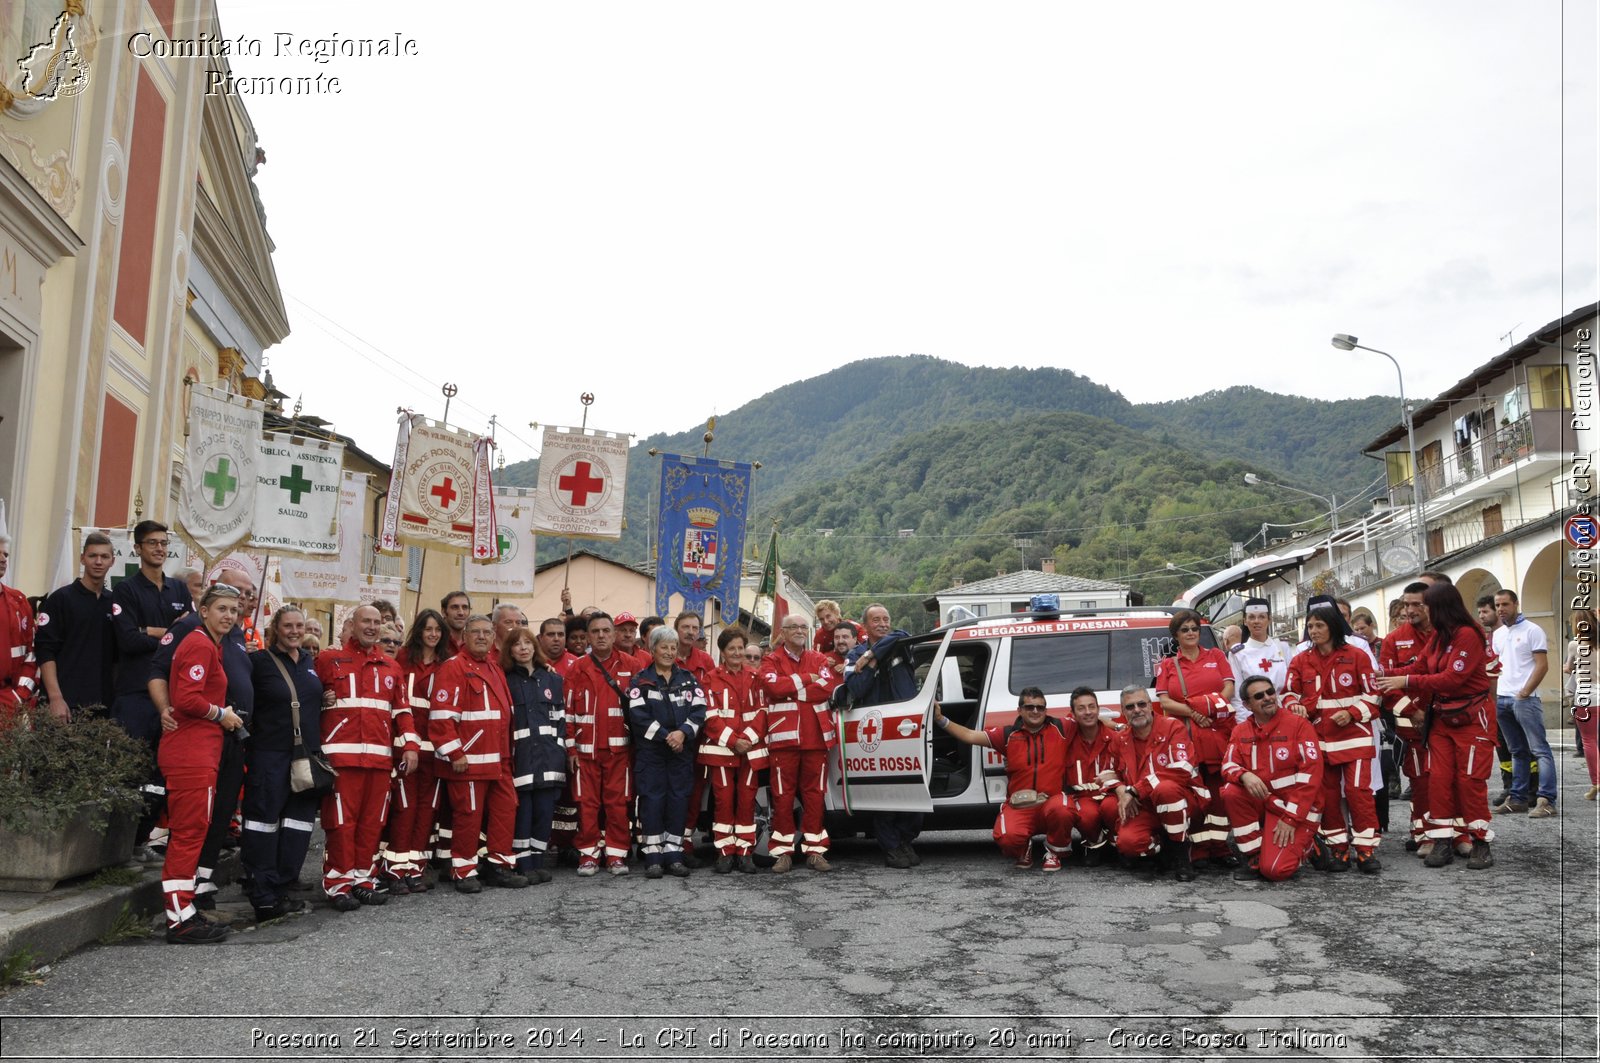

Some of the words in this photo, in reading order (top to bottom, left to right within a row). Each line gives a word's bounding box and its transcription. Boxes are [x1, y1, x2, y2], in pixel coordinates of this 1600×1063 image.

[544, 440, 570, 450] CROCE
[571, 443, 596, 453] ROSSA
[597, 447, 627, 456] ITALIANA
[261, 446, 291, 458] UBBLICA
[297, 453, 338, 465] ASSISTENZA
[278, 508, 308, 519] SALUZZO
[547, 515, 598, 526] DELEGAZIONE
[402, 522, 439, 535] COMITATO
[552, 523, 599, 533] DRONERO
[249, 534, 290, 545] OLONTARI
[969, 624, 1053, 637] DELEGAZIONE
[1057, 623, 1069, 631] DI
[1073, 619, 1129, 630] PAESANA
[880, 757, 922, 771] ROSSA
